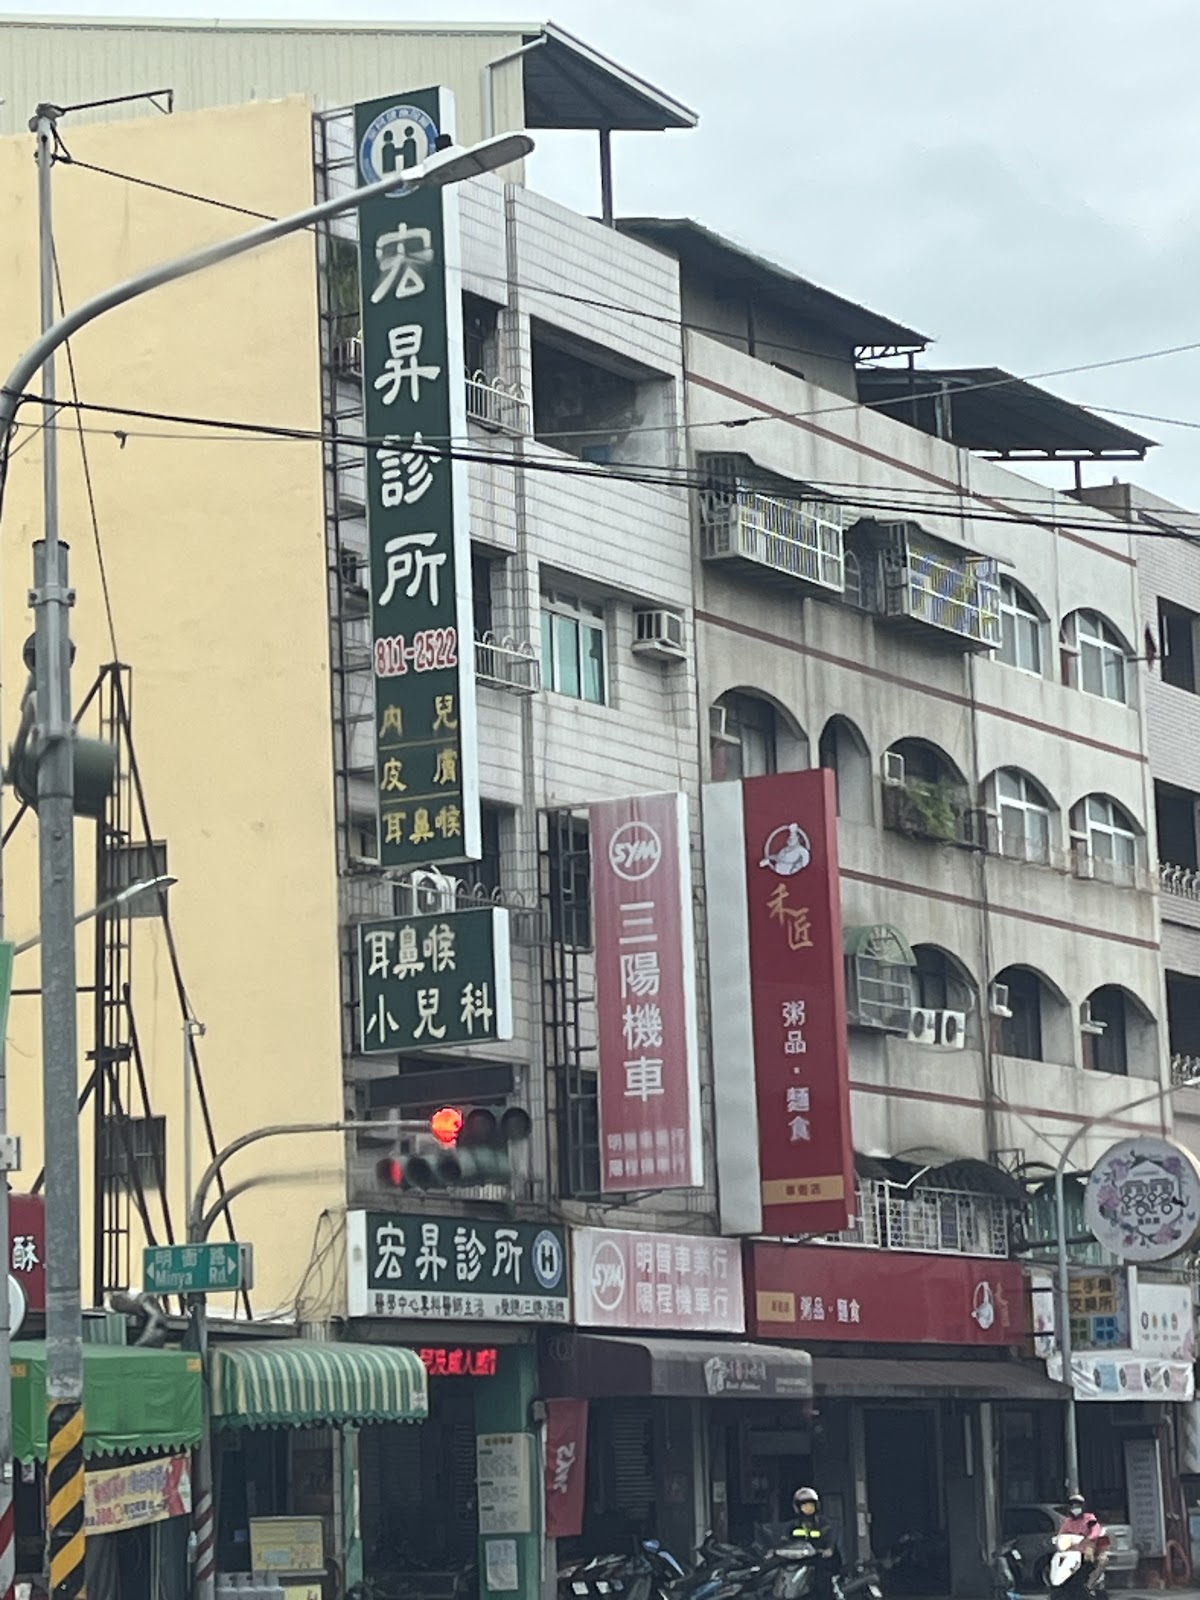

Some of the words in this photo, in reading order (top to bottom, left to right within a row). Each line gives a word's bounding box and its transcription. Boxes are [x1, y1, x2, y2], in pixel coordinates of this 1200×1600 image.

[370, 222, 446, 607] 宏昇診所
[375, 627, 458, 678] 811-2522
[381, 804, 462, 845] 耳鼻喉
[364, 923, 456, 980] 耳鼻喉
[366, 982, 493, 1043] 小兒科
[618, 900, 665, 1102] 三陽機車
[374, 1221, 523, 1285] 宏昇診所
